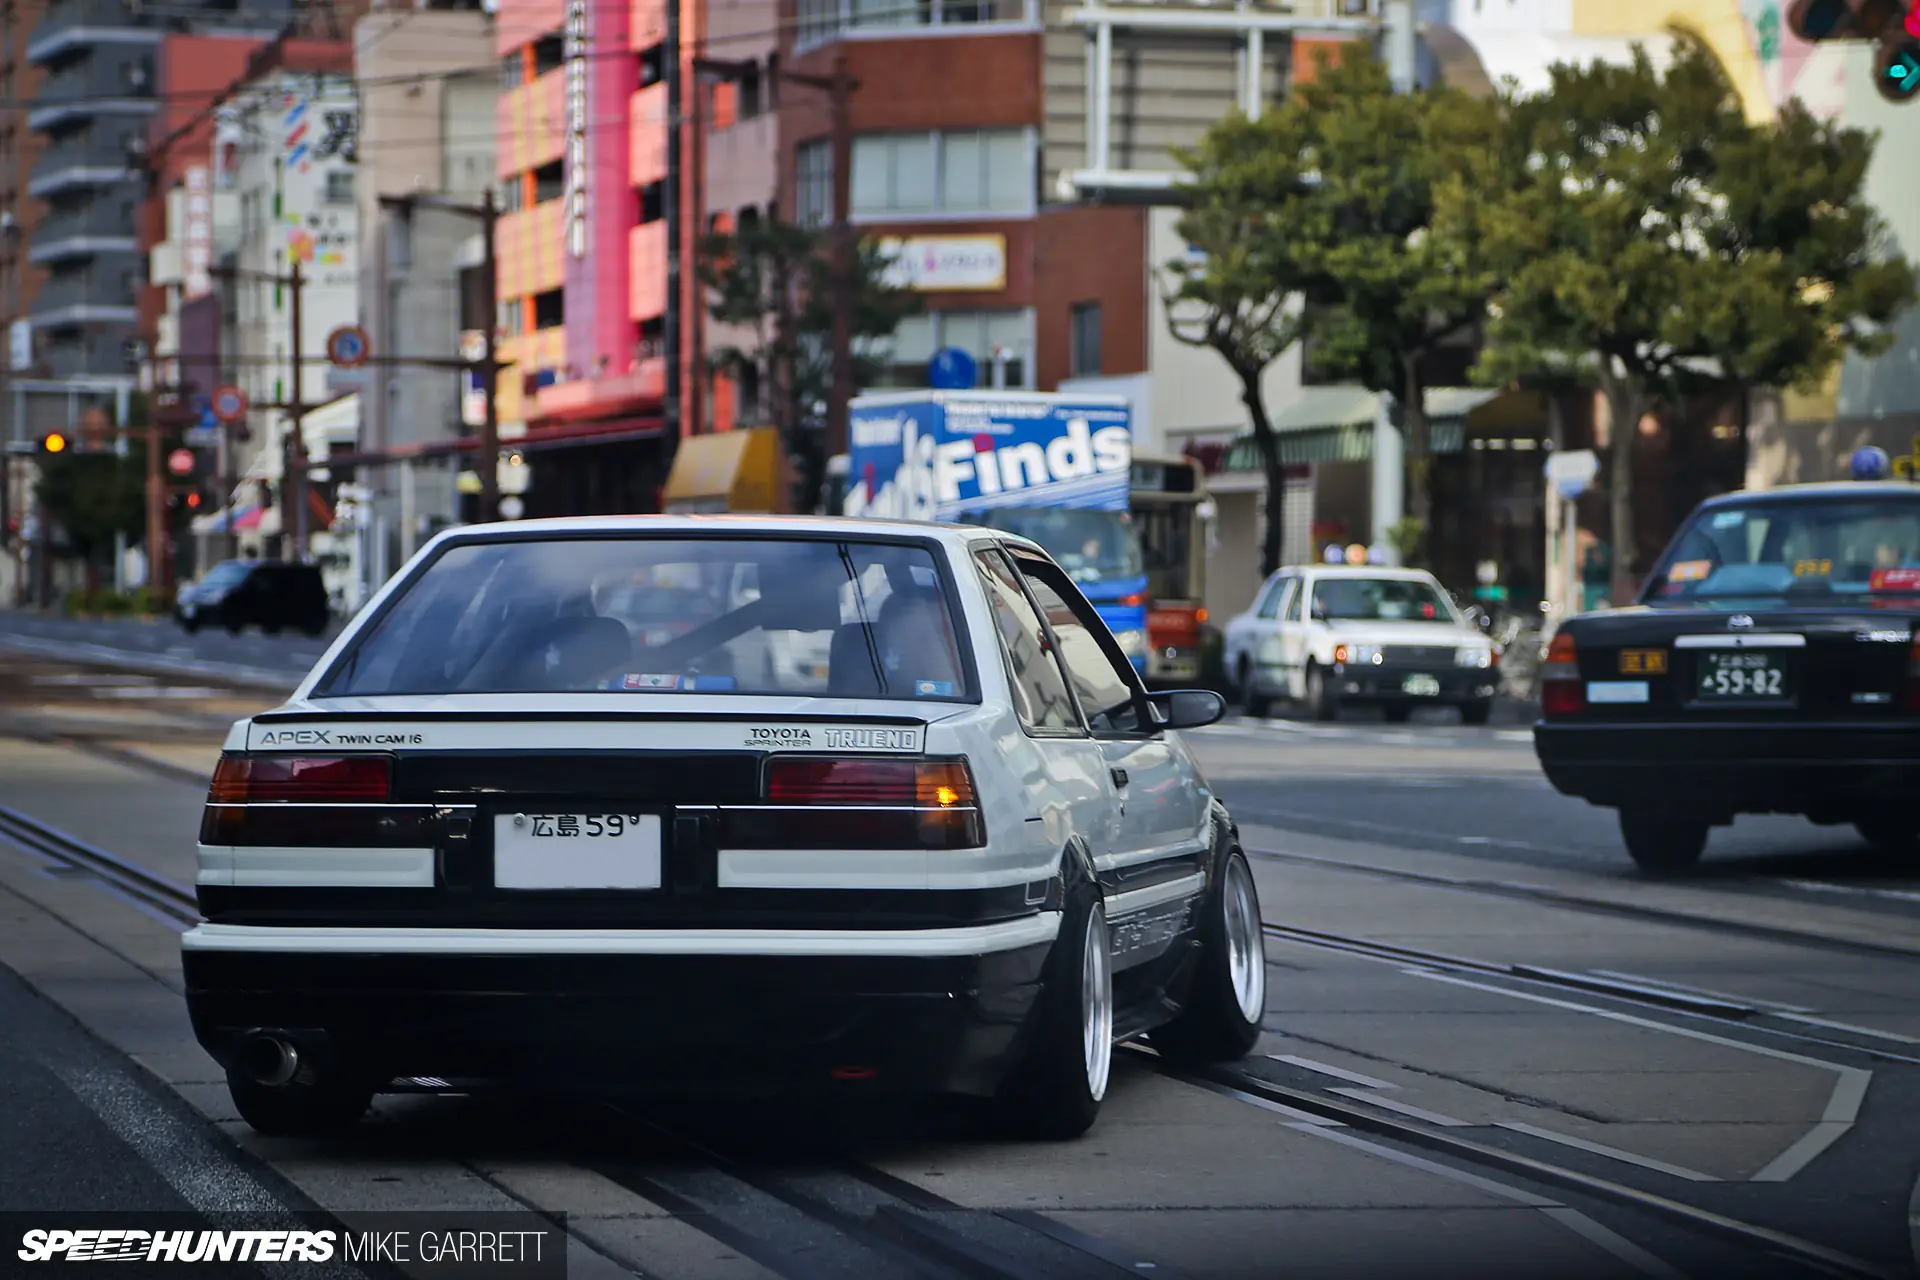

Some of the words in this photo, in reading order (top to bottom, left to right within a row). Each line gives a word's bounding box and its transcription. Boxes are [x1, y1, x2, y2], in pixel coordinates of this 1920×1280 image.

[933, 417, 1132, 502] Finds
[1715, 668, 1782, 695] 59-82
[260, 730, 331, 745] APEX
[337, 735, 371, 744] TWIN
[374, 734, 405, 744] CAM
[408, 734, 423, 744] 16
[743, 739, 812, 747] SPRINTER
[750, 728, 811, 739] TOYOTA
[825, 728, 917, 750] TRUENO
[531, 815, 580, 837] 広島
[586, 815, 624, 837] 59
